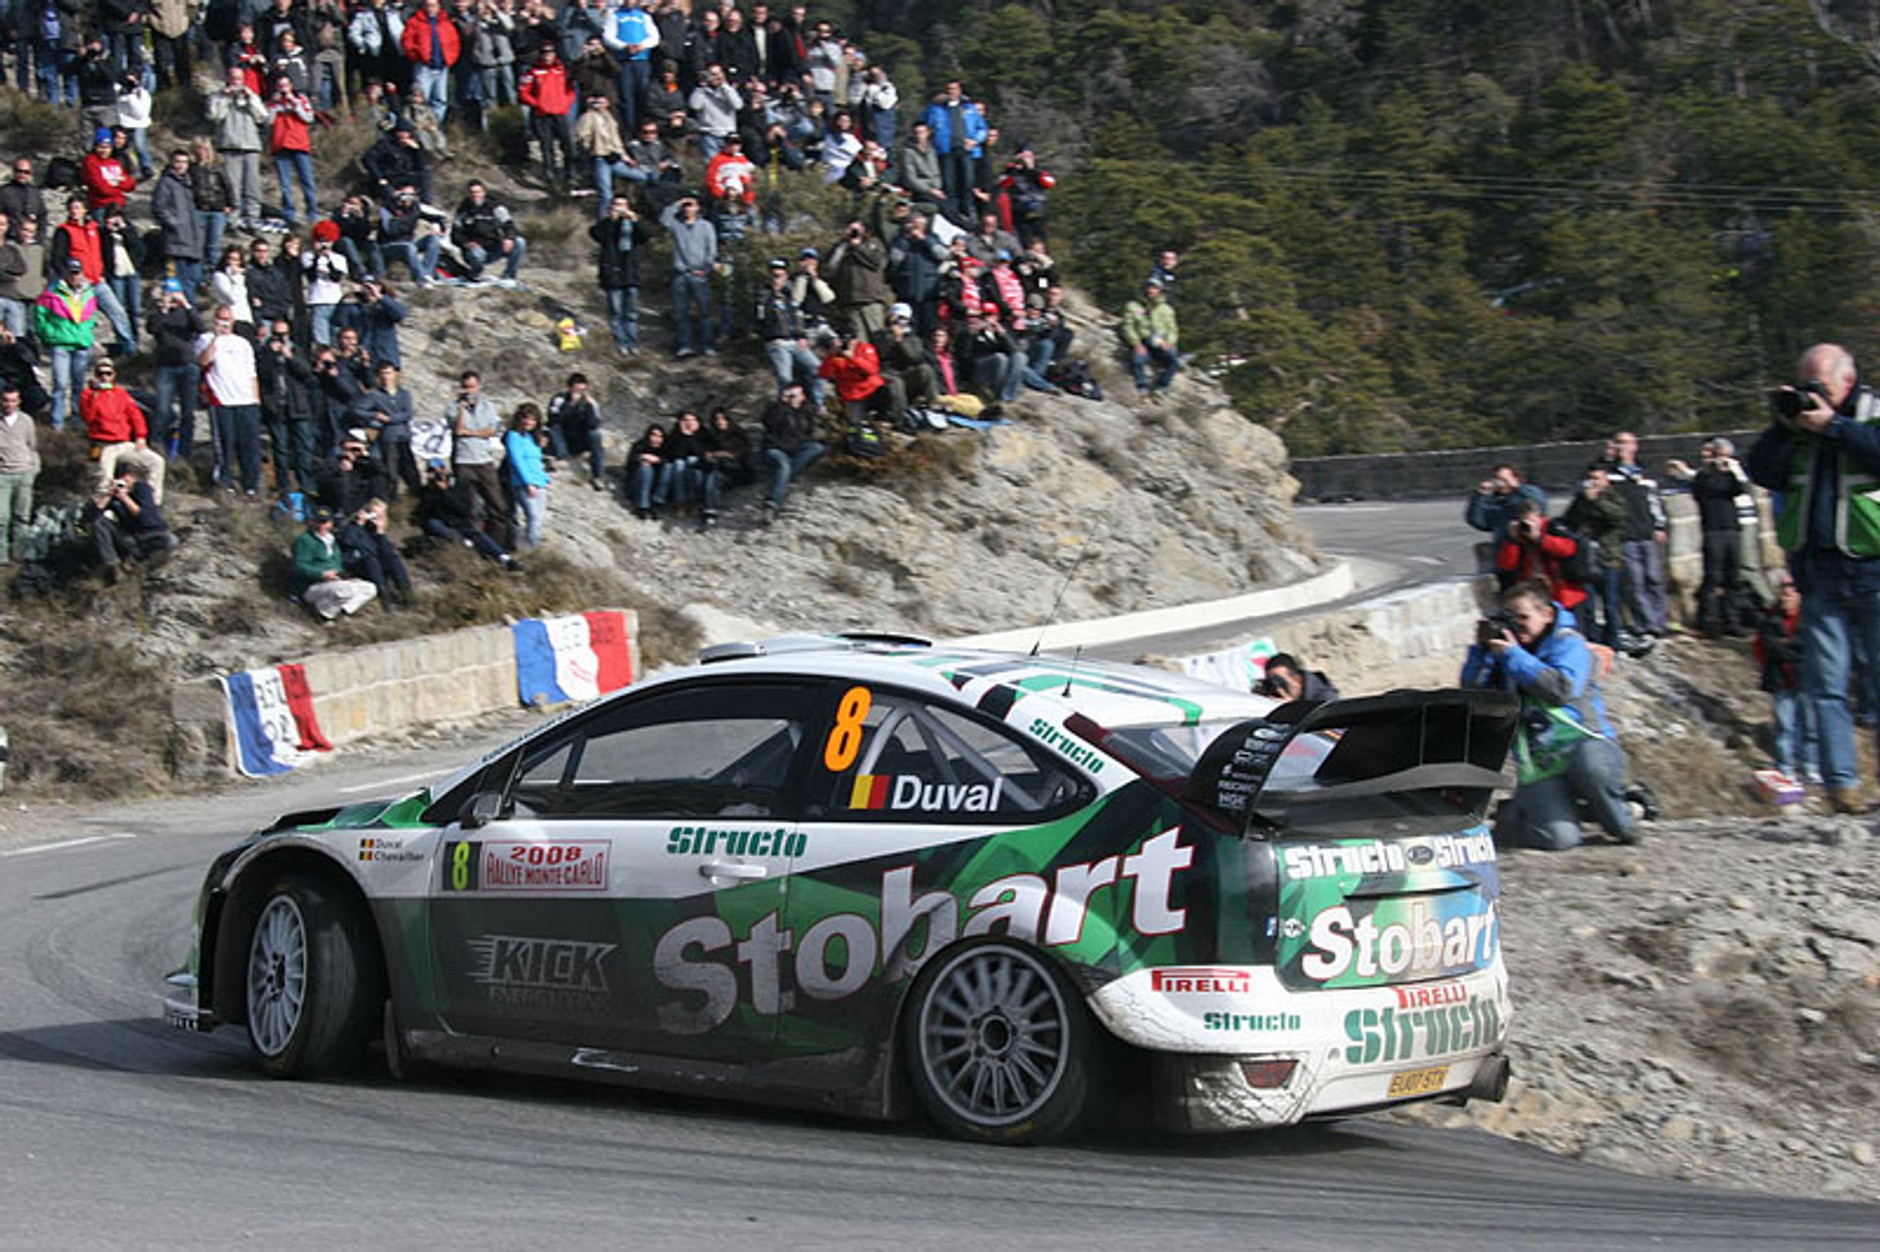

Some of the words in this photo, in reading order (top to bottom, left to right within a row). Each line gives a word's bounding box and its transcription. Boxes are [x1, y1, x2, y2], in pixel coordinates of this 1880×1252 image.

[824, 686, 872, 772] 8
[1029, 718, 1105, 774] Structo
[891, 776, 1001, 812] Duval
[375, 838, 403, 849] Duval
[510, 846, 582, 865] 2008
[667, 826, 808, 857] Structo
[1284, 838, 1404, 880] Structo
[452, 842, 470, 889] 8
[487, 851, 523, 884] RALLYE
[653, 825, 1194, 1034] Stobart
[1302, 901, 1497, 981] Stobart
[487, 937, 612, 990] KICK
[1151, 969, 1250, 993] PIRELLI
[1390, 981, 1467, 1008] PIRELLI
[1203, 1012, 1300, 1031] Structo
[1344, 995, 1499, 1064] Structo
